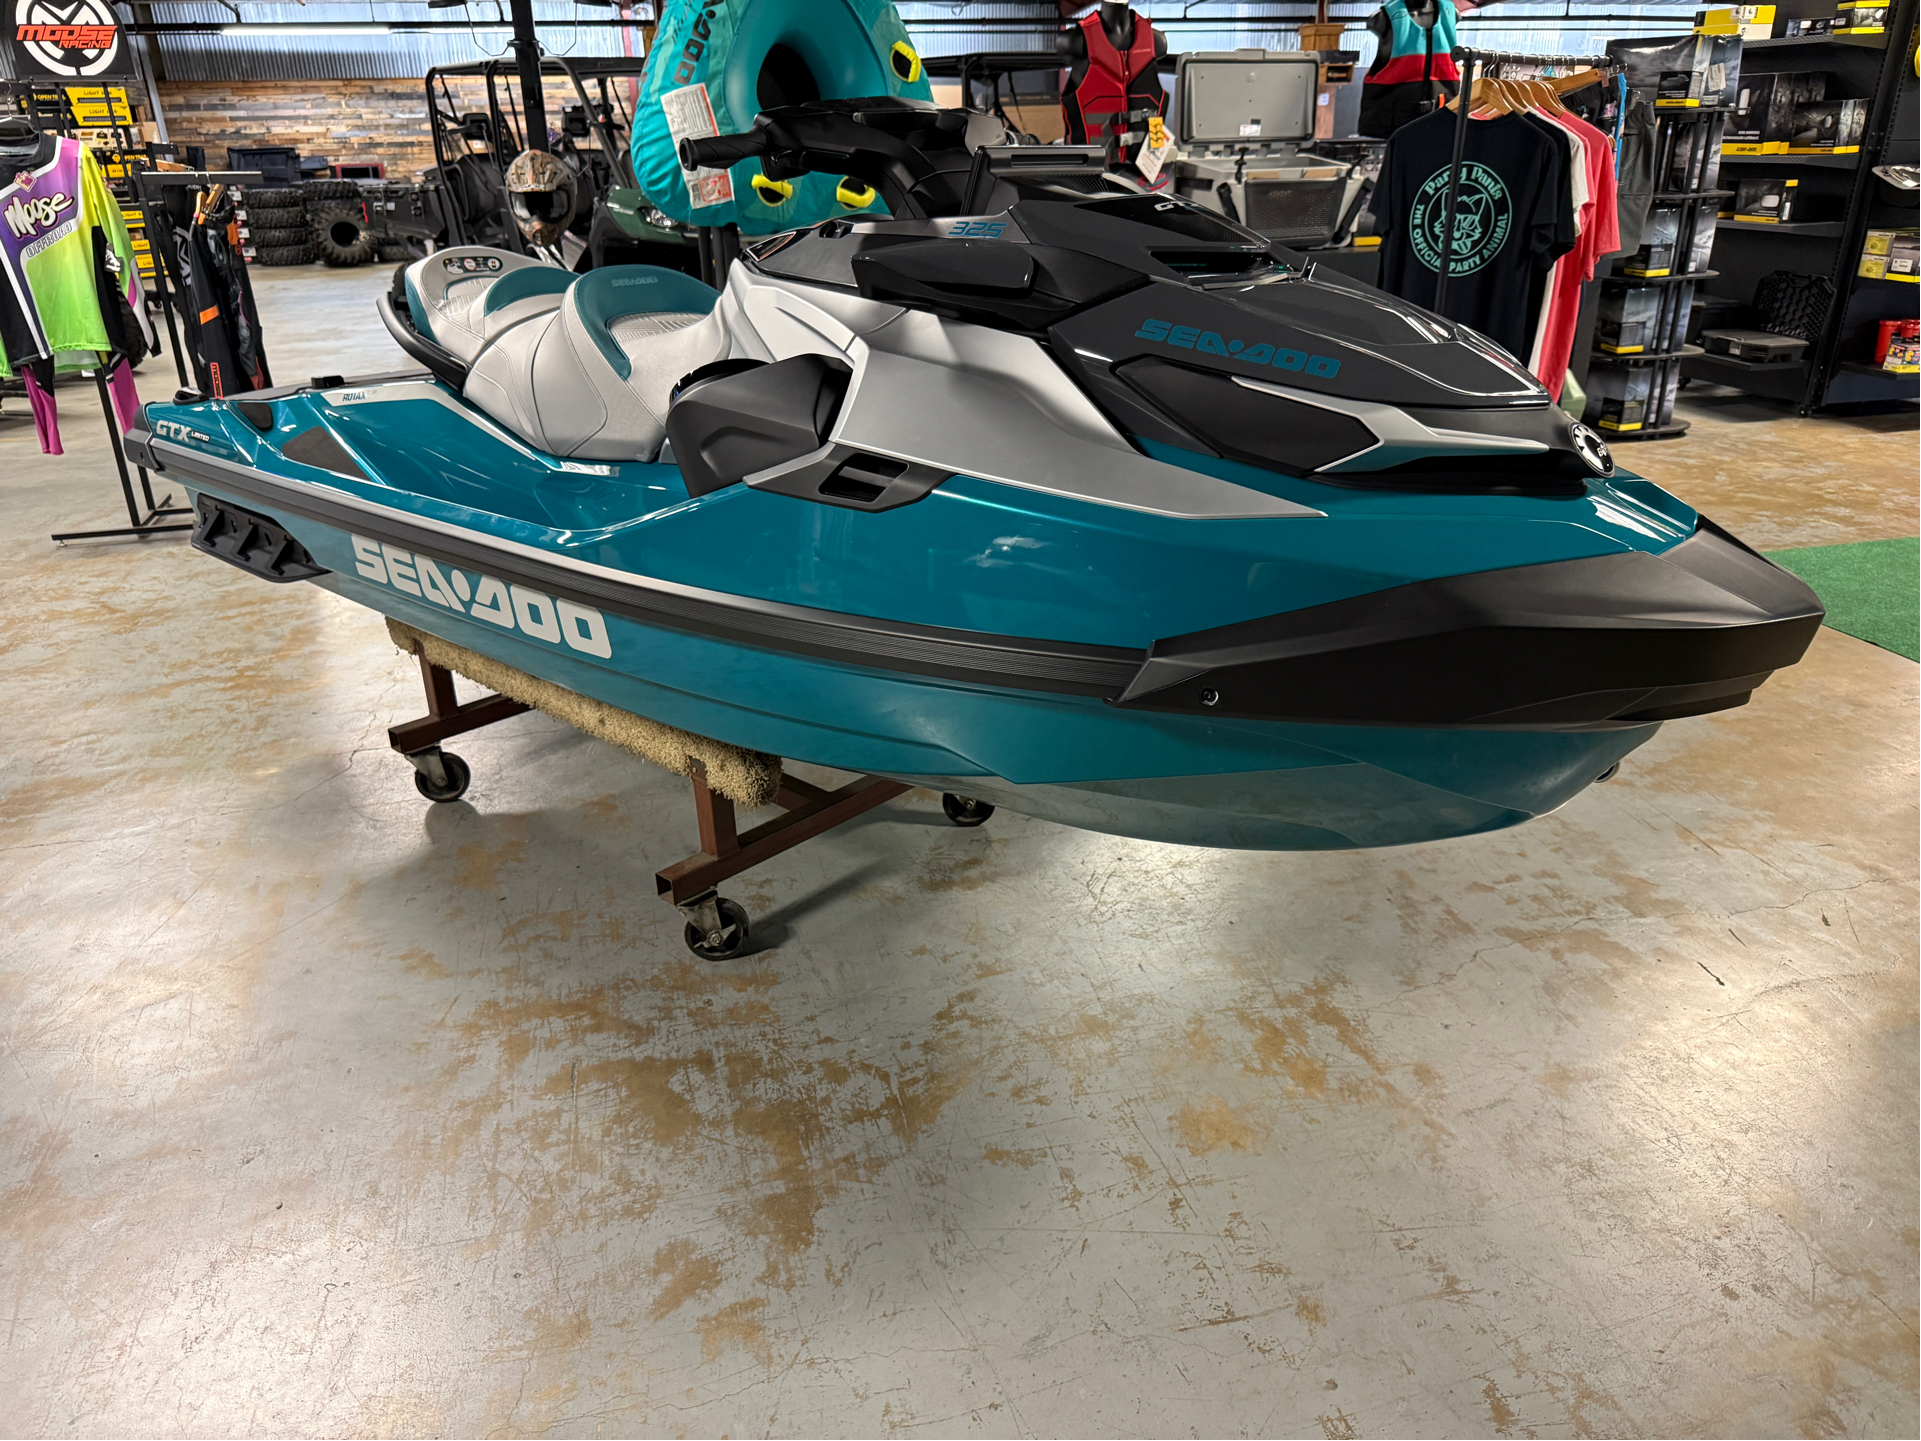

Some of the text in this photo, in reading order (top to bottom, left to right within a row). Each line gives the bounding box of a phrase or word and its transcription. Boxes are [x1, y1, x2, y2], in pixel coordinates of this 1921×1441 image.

[16, 25, 118, 41] MOOSE
[59, 40, 112, 49] RACING
[1424, 167, 1503, 200] Pary Pants
[4, 192, 74, 238] Moose
[26, 221, 73, 258] OFFROAD
[948, 221, 1008, 239] 325
[1413, 204, 1425, 226] THE
[1448, 254, 1481, 272] PARTY
[1482, 212, 1508, 260] ANIMAL
[156, 420, 192, 442] GTX
